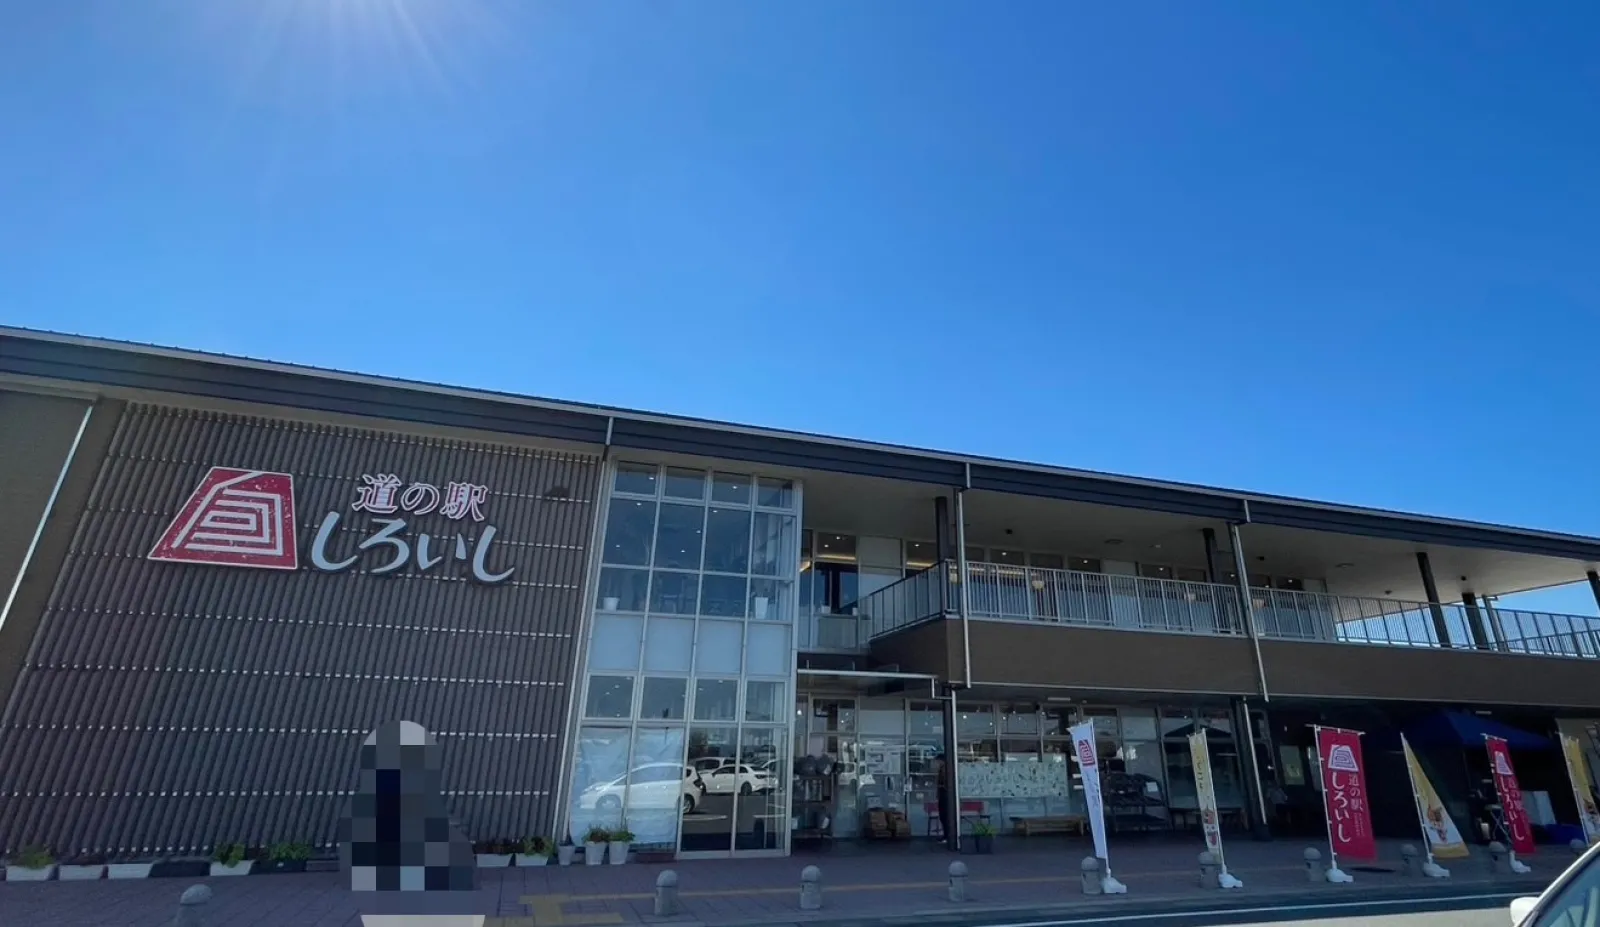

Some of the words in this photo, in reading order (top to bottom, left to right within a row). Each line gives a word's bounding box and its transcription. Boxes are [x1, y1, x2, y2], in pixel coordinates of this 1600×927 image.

[352, 473, 489, 522] 道の駅
[311, 511, 516, 584] しろいし
[1332, 771, 1351, 843] しろいし
[1500, 775, 1525, 841] しろいし
